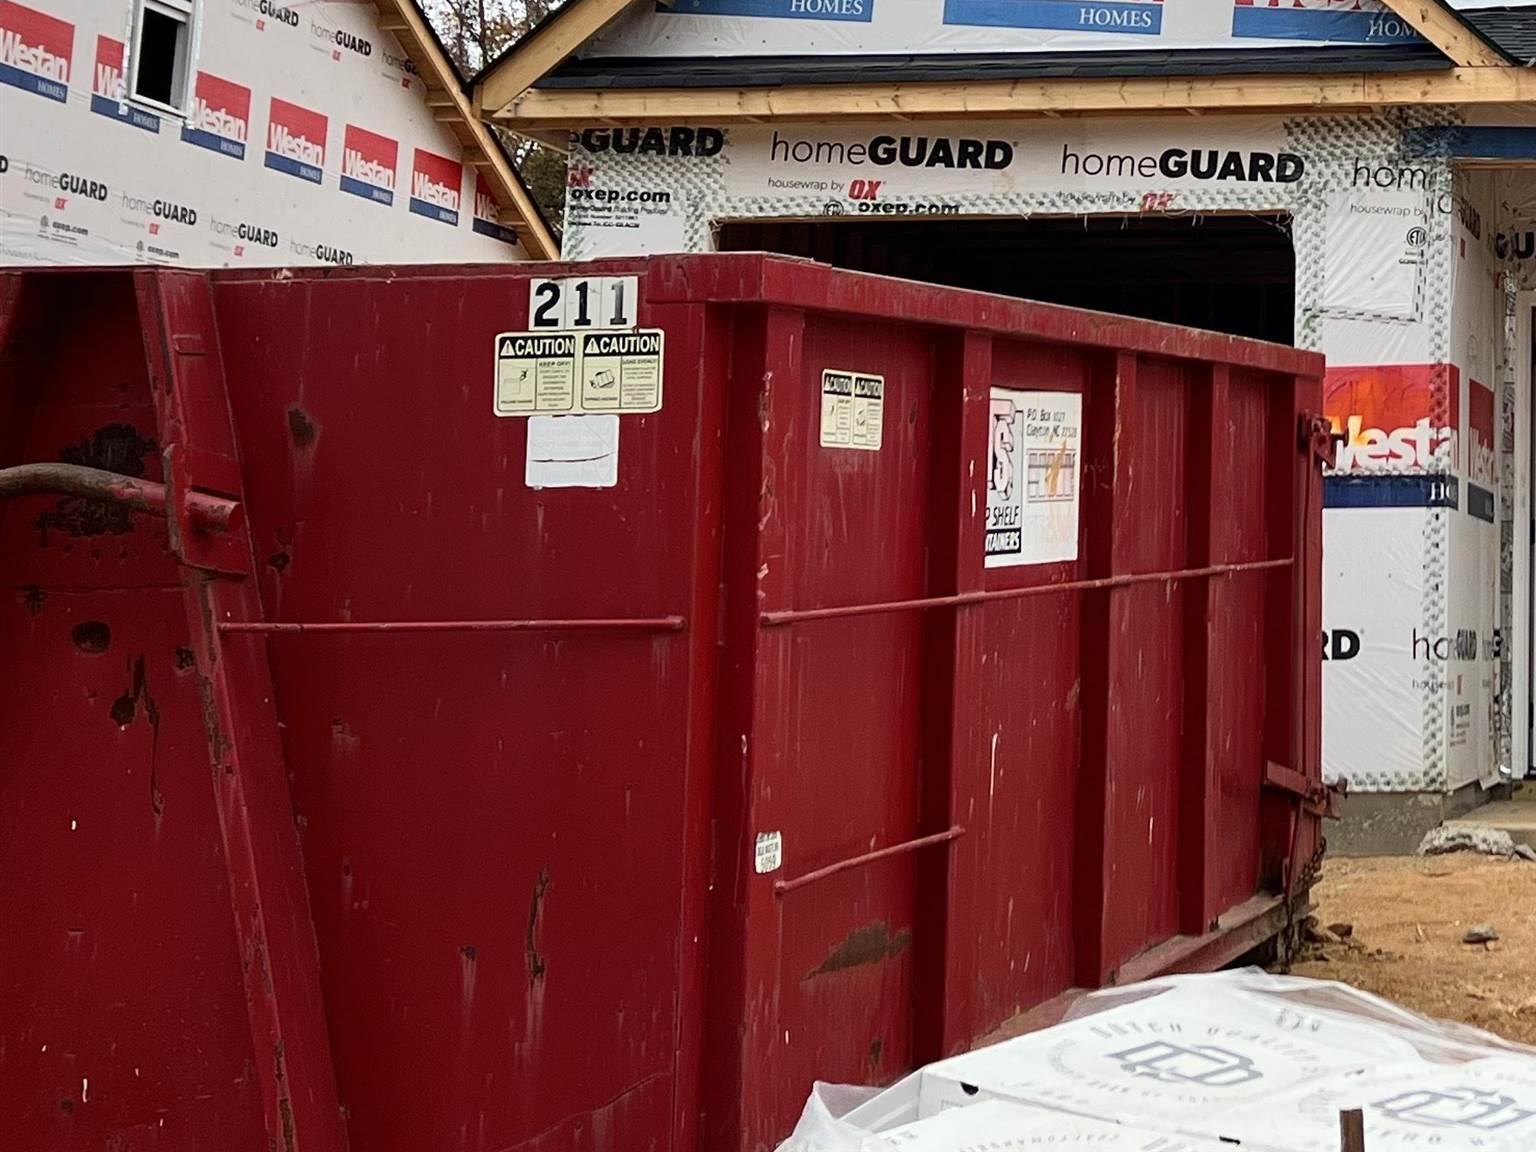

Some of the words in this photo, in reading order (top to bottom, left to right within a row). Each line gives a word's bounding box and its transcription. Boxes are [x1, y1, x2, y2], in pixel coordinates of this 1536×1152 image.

[1078, 7, 1153, 28] HOMES
[1368, 19, 1418, 38] HOM
[270, 123, 323, 166] Westan
[771, 131, 1014, 170] homeGUARD
[345, 148, 394, 188] Westan
[1061, 144, 1305, 184] homeGUARD
[25, 165, 108, 201] homeGUARD
[413, 171, 459, 209] Westan
[768, 178, 828, 191] housewrap
[831, 179, 845, 192] by
[848, 179, 881, 201] OX
[122, 191, 197, 225] homeGUARD
[476, 193, 501, 220] Wes
[570, 189, 671, 205] oxep.com
[1351, 204, 1411, 217] housewrap
[533, 279, 628, 328] 211
[514, 338, 575, 356] CAUTION
[599, 335, 660, 354] CAUTION
[992, 505, 1020, 527] SHELF
